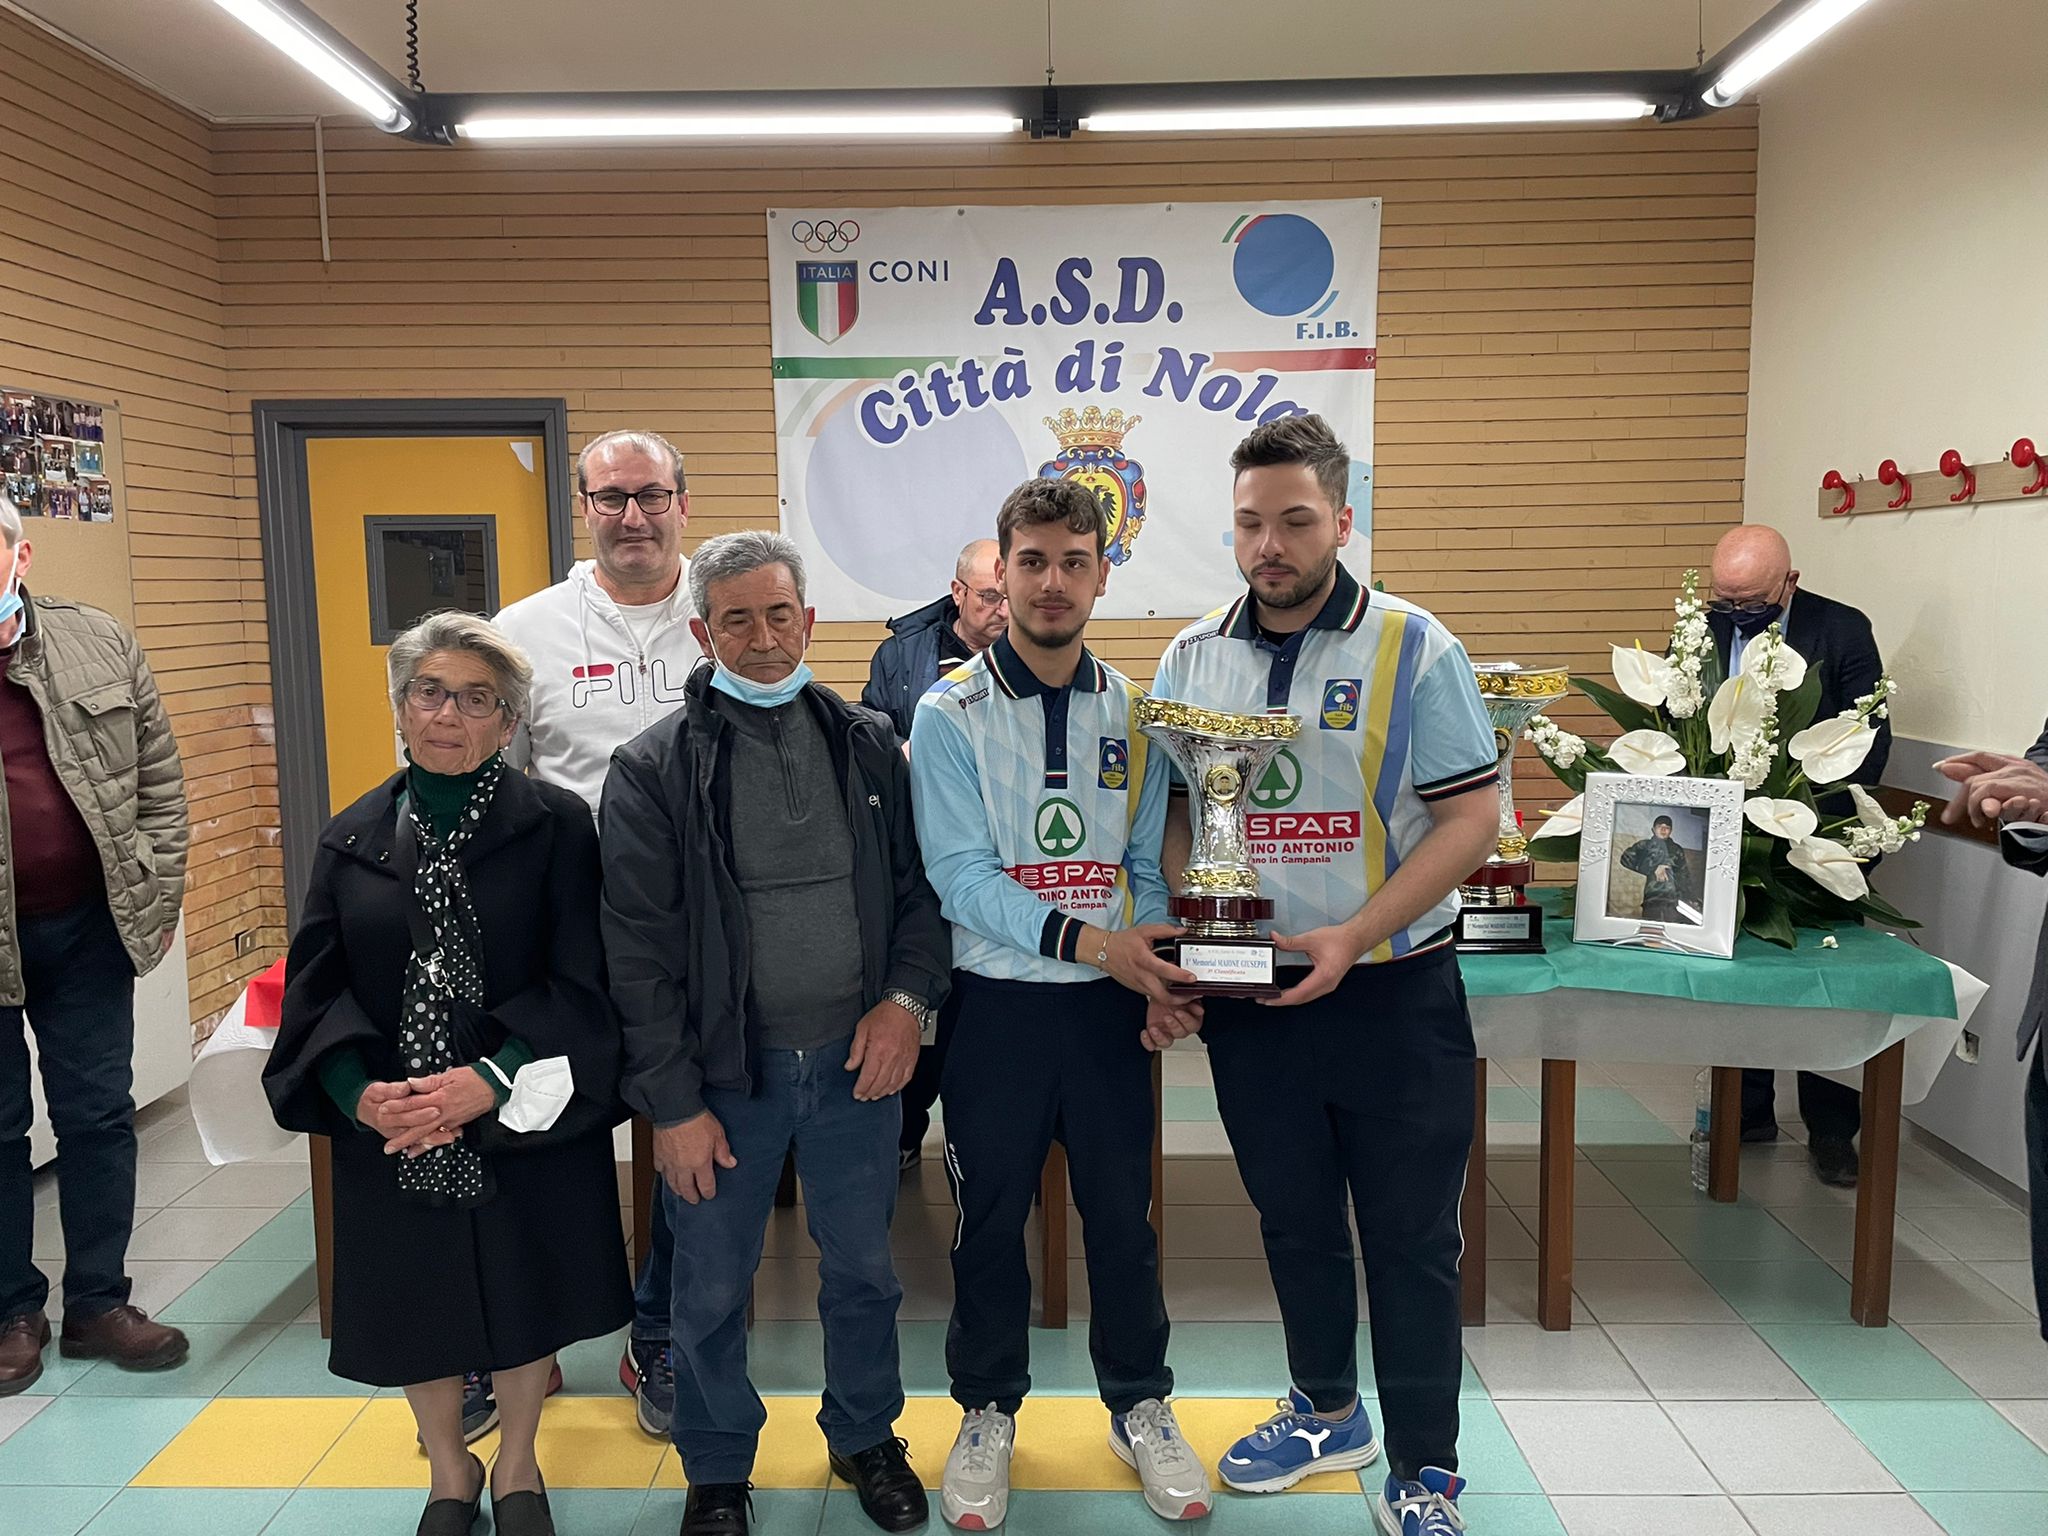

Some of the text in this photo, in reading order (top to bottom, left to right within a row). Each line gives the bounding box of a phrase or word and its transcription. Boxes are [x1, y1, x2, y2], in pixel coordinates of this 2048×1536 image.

[803, 266, 853, 279] ITALIA
[869, 260, 949, 282] CONI
[974, 257, 1184, 325] A.S.D.
[1296, 321, 1359, 340] F.I.B.
[860, 346, 1033, 445] Città
[1055, 339, 1125, 393] di
[572, 656, 707, 709] FIL
[1249, 816, 1353, 836] SPAR
[1251, 841, 1355, 855] INO ANTONIO
[1269, 856, 1278, 864] in
[1281, 855, 1332, 865] Campania
[1008, 864, 1117, 887] ESPAR
[1038, 890, 1067, 902] DINO
